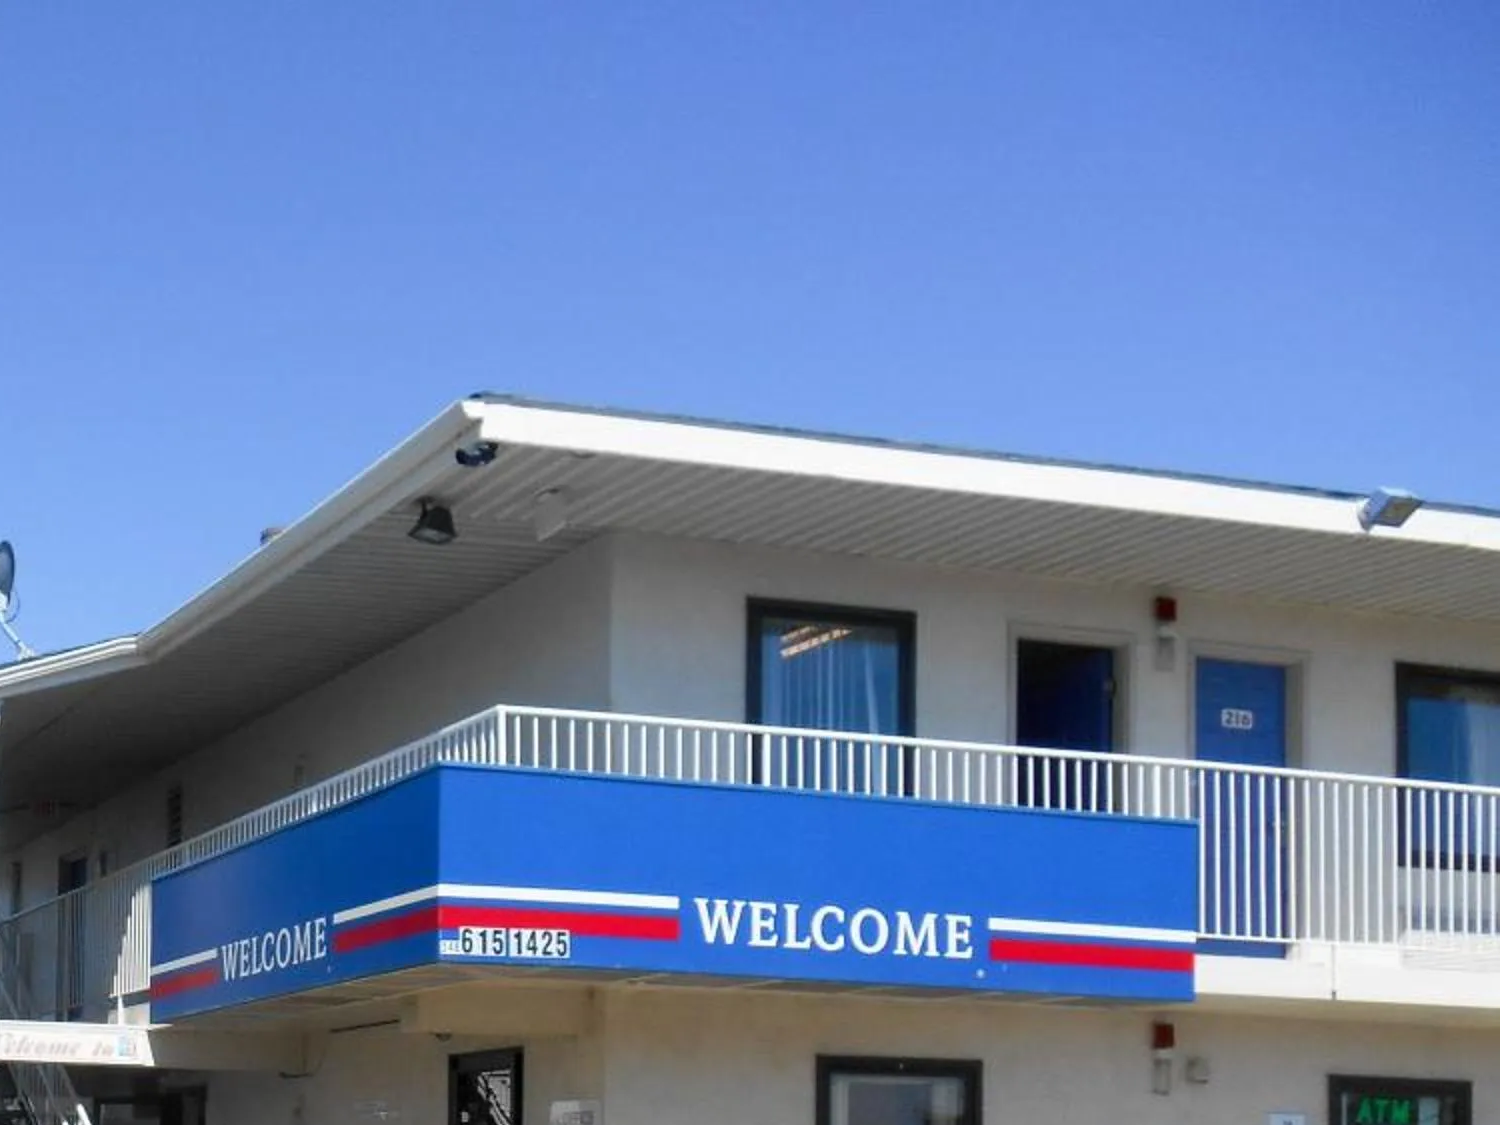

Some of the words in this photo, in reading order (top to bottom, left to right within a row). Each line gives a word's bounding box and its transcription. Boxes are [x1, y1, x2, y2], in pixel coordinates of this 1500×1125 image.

[221, 917, 327, 981] WELCOME
[461, 928, 503, 955] 615
[513, 931, 567, 957] 1425
[694, 897, 973, 959] WELCOME
[1356, 1098, 1411, 1124] ATM
